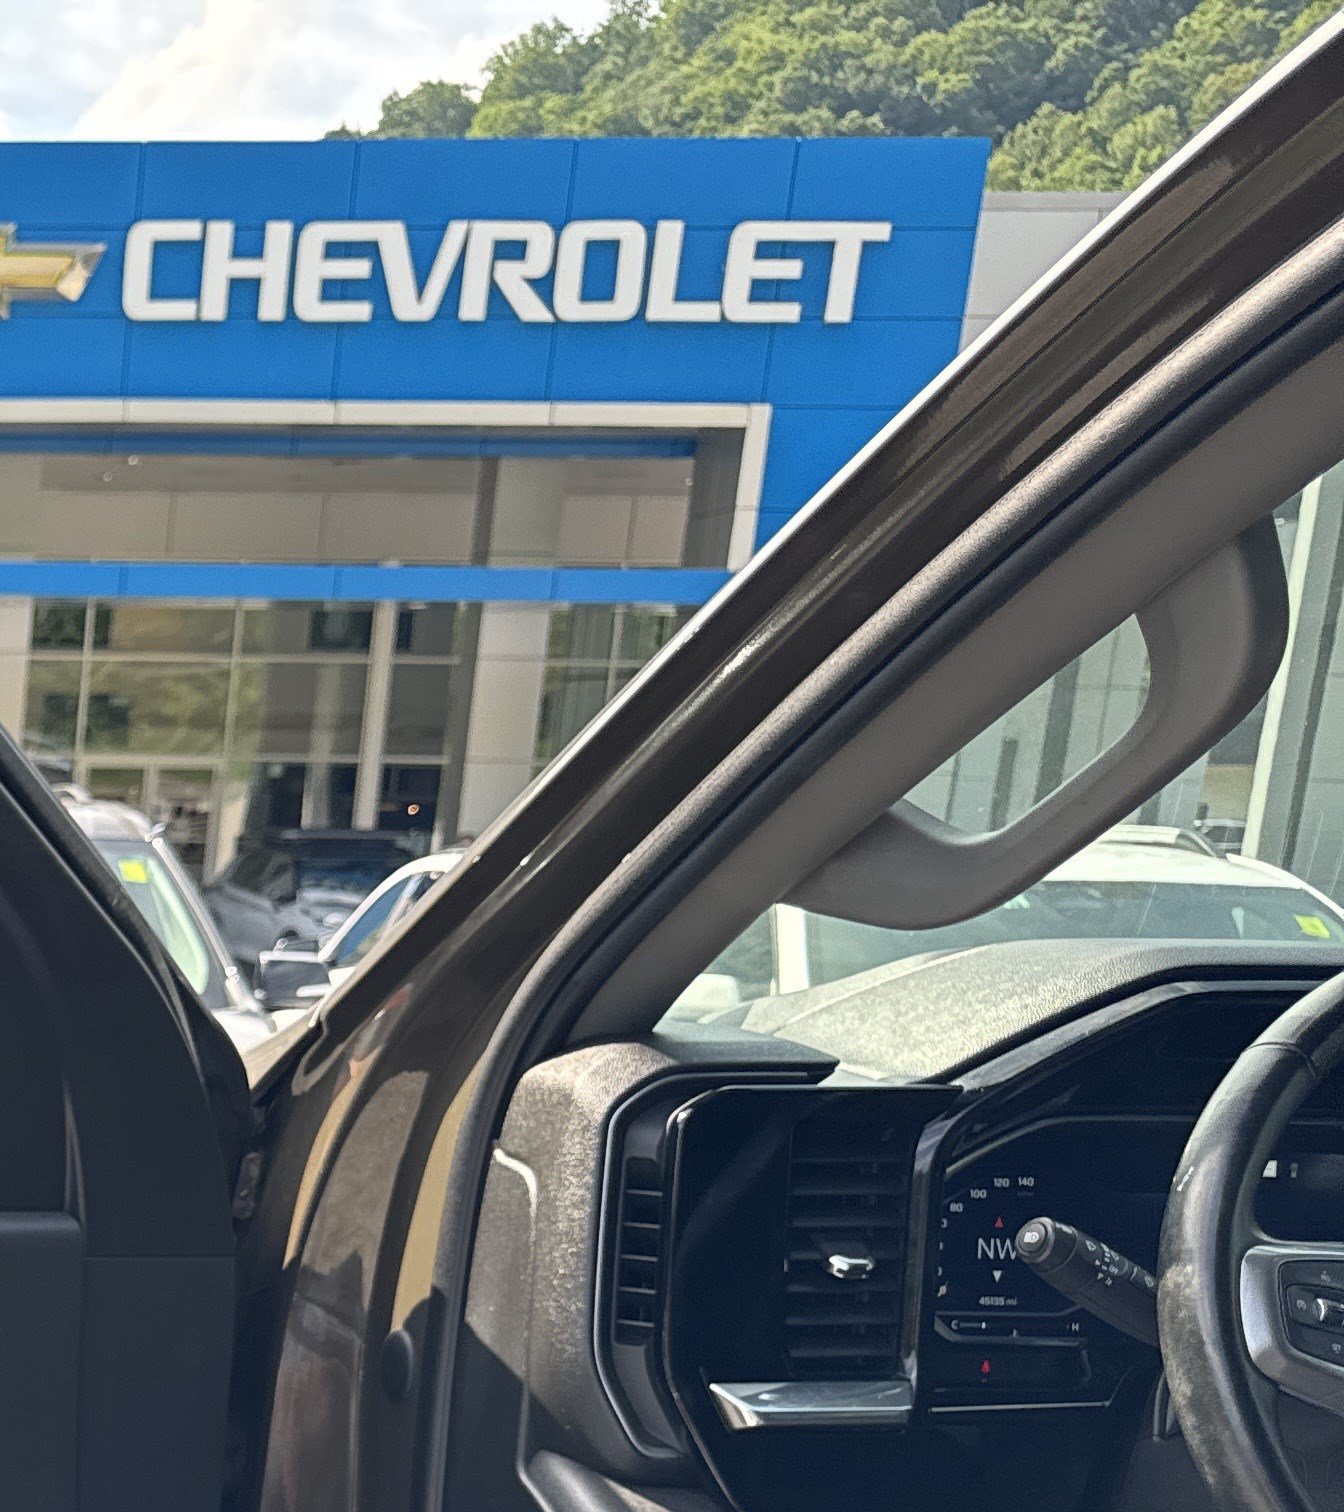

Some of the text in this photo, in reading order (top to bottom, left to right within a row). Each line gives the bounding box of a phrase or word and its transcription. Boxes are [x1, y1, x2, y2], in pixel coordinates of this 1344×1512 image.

[122, 218, 892, 324] CHEVROLET
[993, 1177, 1010, 1187] 120
[1018, 1176, 1035, 1187] 140
[970, 1189, 987, 1199] 100
[977, 1237, 1017, 1260] NW
